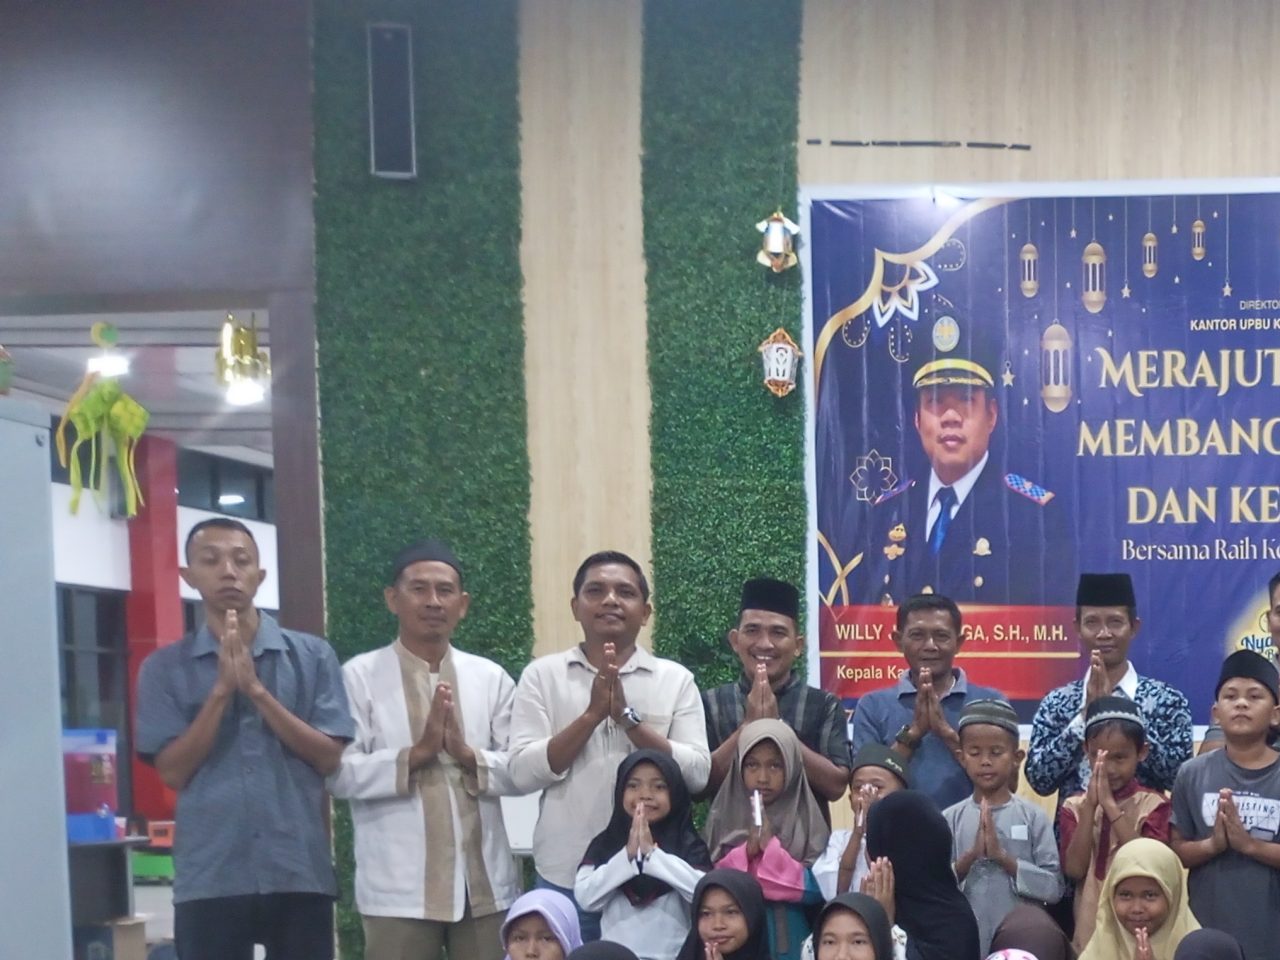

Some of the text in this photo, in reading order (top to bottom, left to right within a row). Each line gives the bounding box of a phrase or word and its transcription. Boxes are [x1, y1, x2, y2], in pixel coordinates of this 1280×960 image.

[1190, 319, 1237, 331] KANTOR
[1239, 318, 1271, 330] UPBU
[1127, 486, 1217, 525] DAN
[1121, 538, 1210, 562] Bersama
[1215, 537, 1258, 561] Raih
[835, 624, 883, 640] WILLY
[993, 624, 1030, 643] S.H.,
[1033, 624, 1068, 641] M.H.
[837, 665, 882, 682] Kepala
